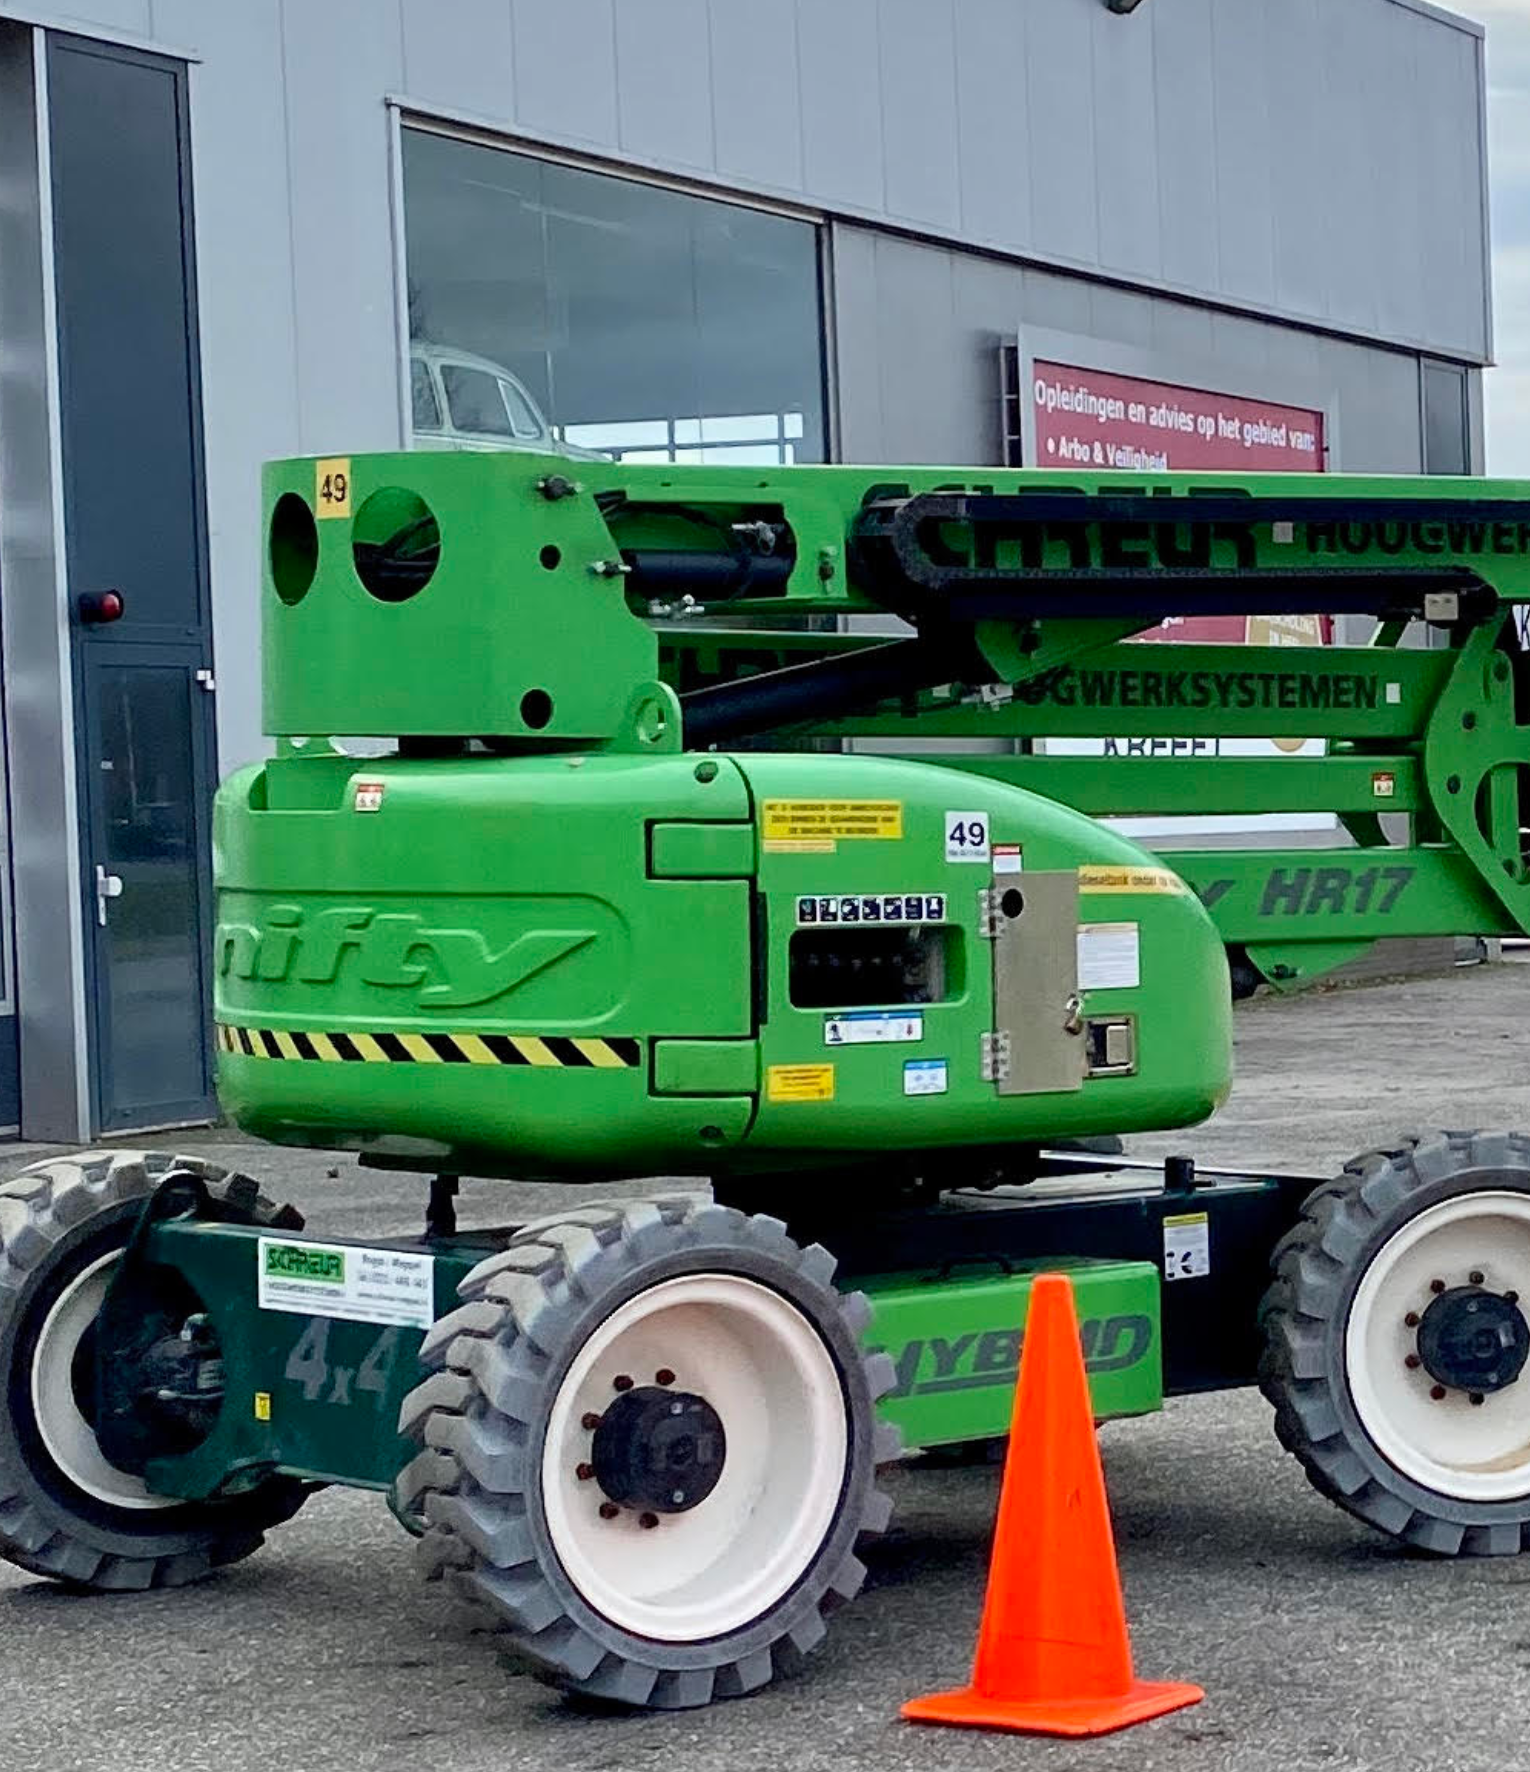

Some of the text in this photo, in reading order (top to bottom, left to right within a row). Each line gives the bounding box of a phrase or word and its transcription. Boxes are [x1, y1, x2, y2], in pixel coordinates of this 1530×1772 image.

[1034, 379, 1124, 422] Opleidingen
[1127, 404, 1146, 424] en
[1149, 403, 1193, 432] advies
[1197, 415, 1215, 438] op
[1218, 412, 1240, 440] het
[1243, 421, 1286, 447] gebied
[1058, 437, 1167, 470] Arbo & Veiligheid
[320, 473, 348, 503] 49
[949, 822, 985, 847] 49
[1258, 867, 1417, 916] HR17
[217, 903, 597, 1010] nifty
